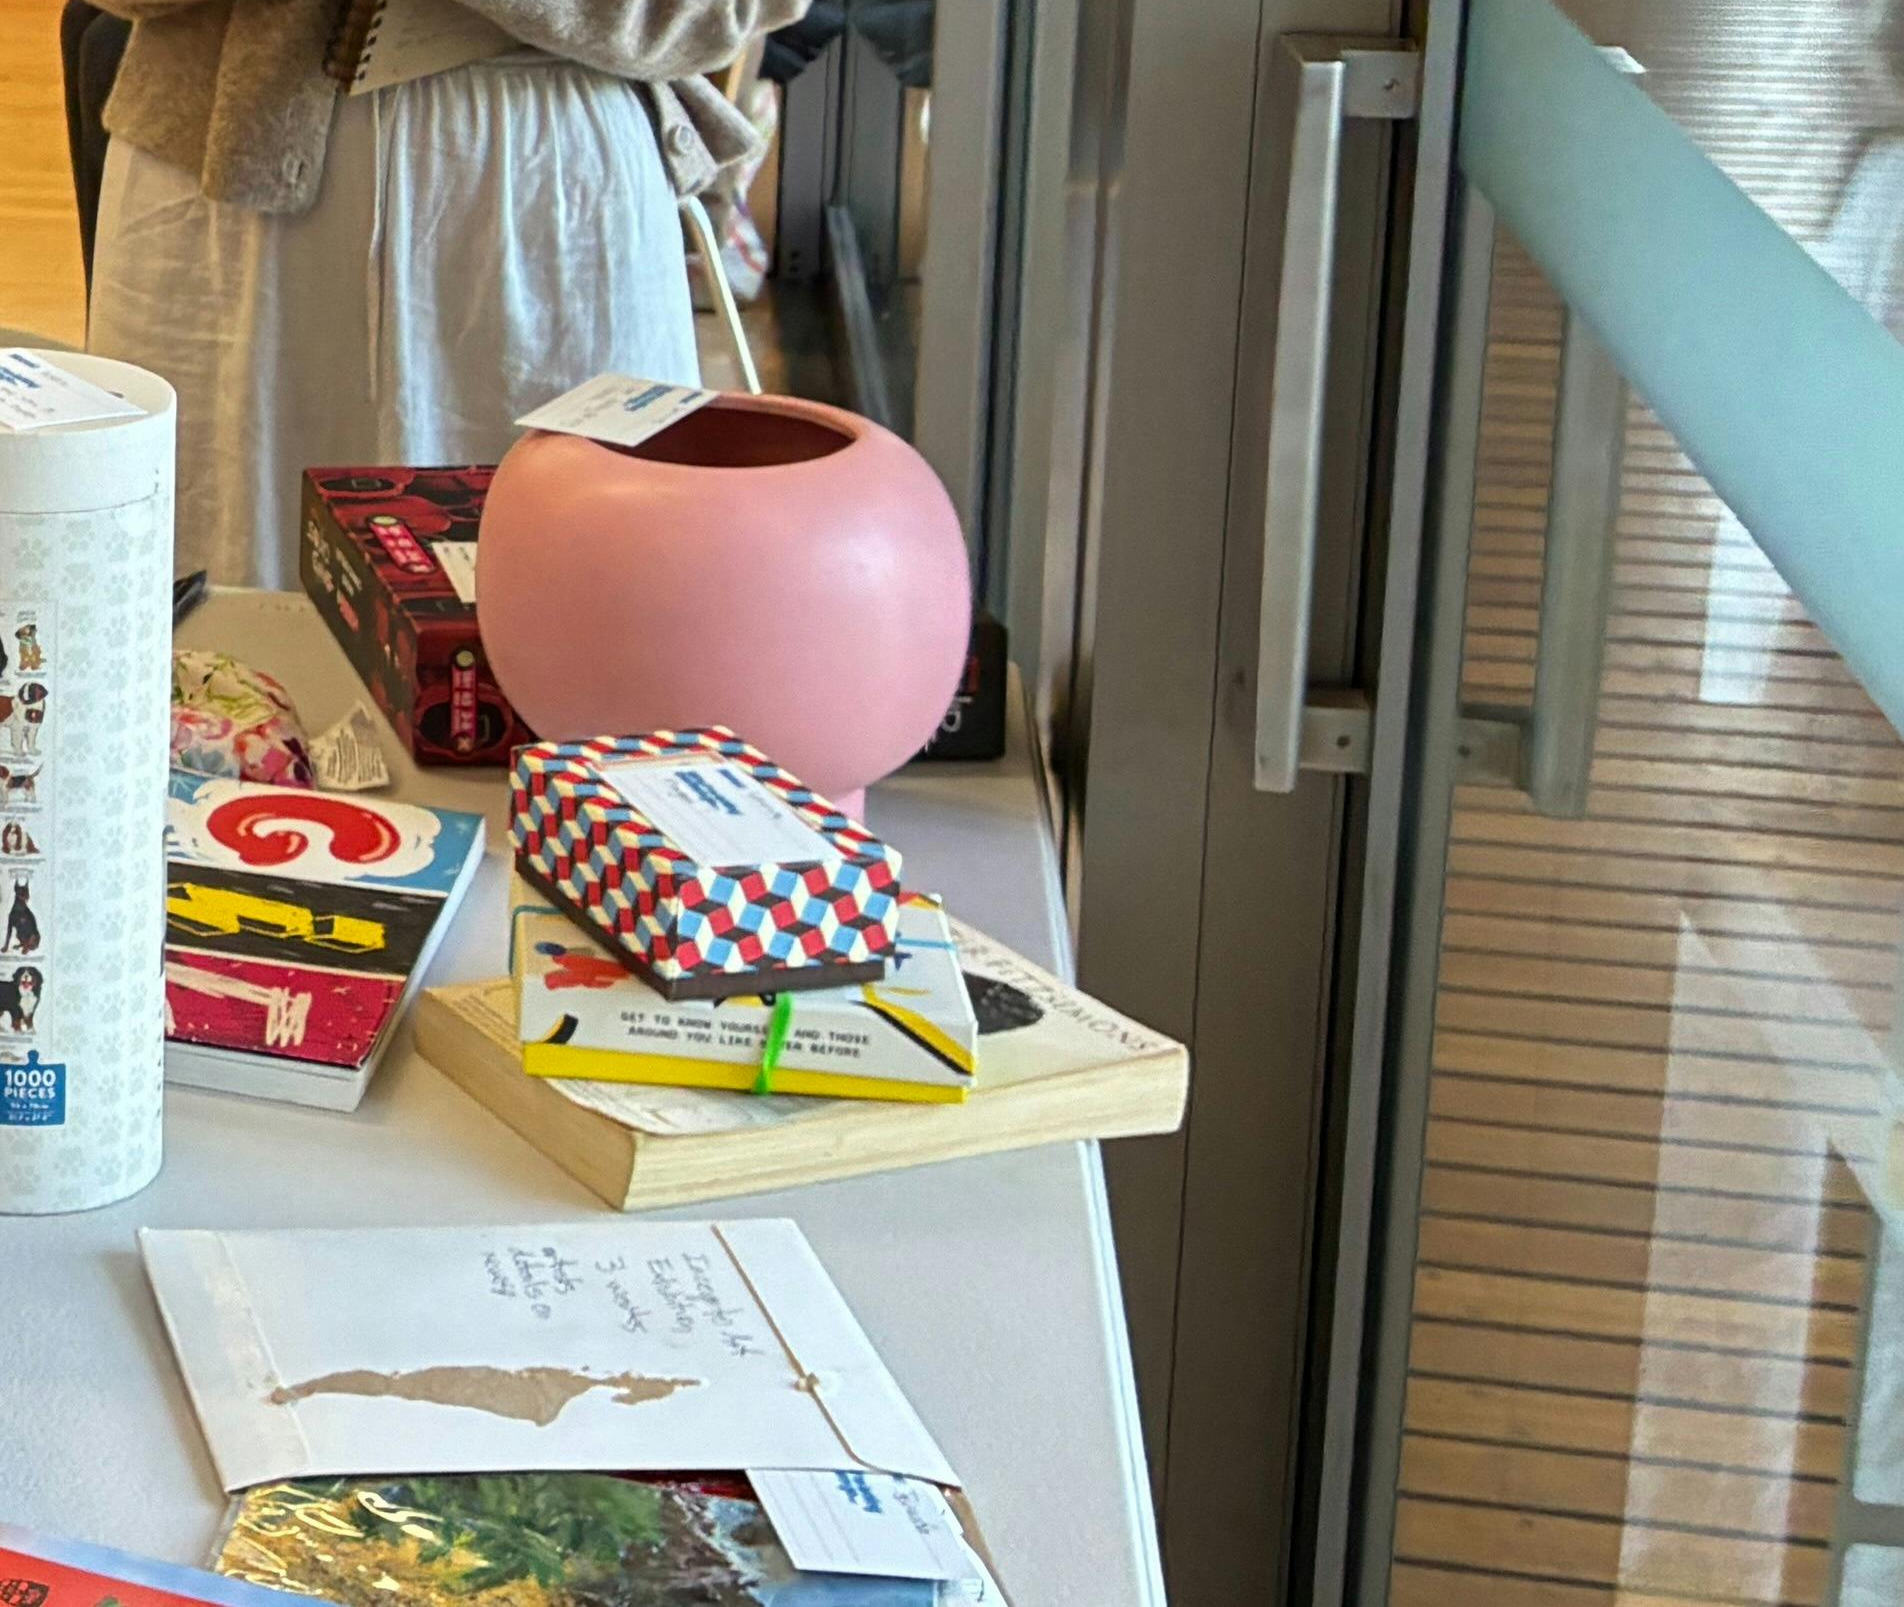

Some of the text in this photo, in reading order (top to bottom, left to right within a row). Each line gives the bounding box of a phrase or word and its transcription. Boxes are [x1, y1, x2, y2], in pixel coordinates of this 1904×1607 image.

[654, 1013, 671, 1026] TO
[794, 1028, 820, 1041] AND
[829, 1031, 871, 1045] THOSE
[628, 1025, 679, 1041] AROUND
[686, 1031, 712, 1045] YOU
[719, 1034, 754, 1049] LIKE
[810, 1043, 861, 1059] BEFORE
[4, 1068, 57, 1087] 1000
[3, 1086, 57, 1099] PIECES
